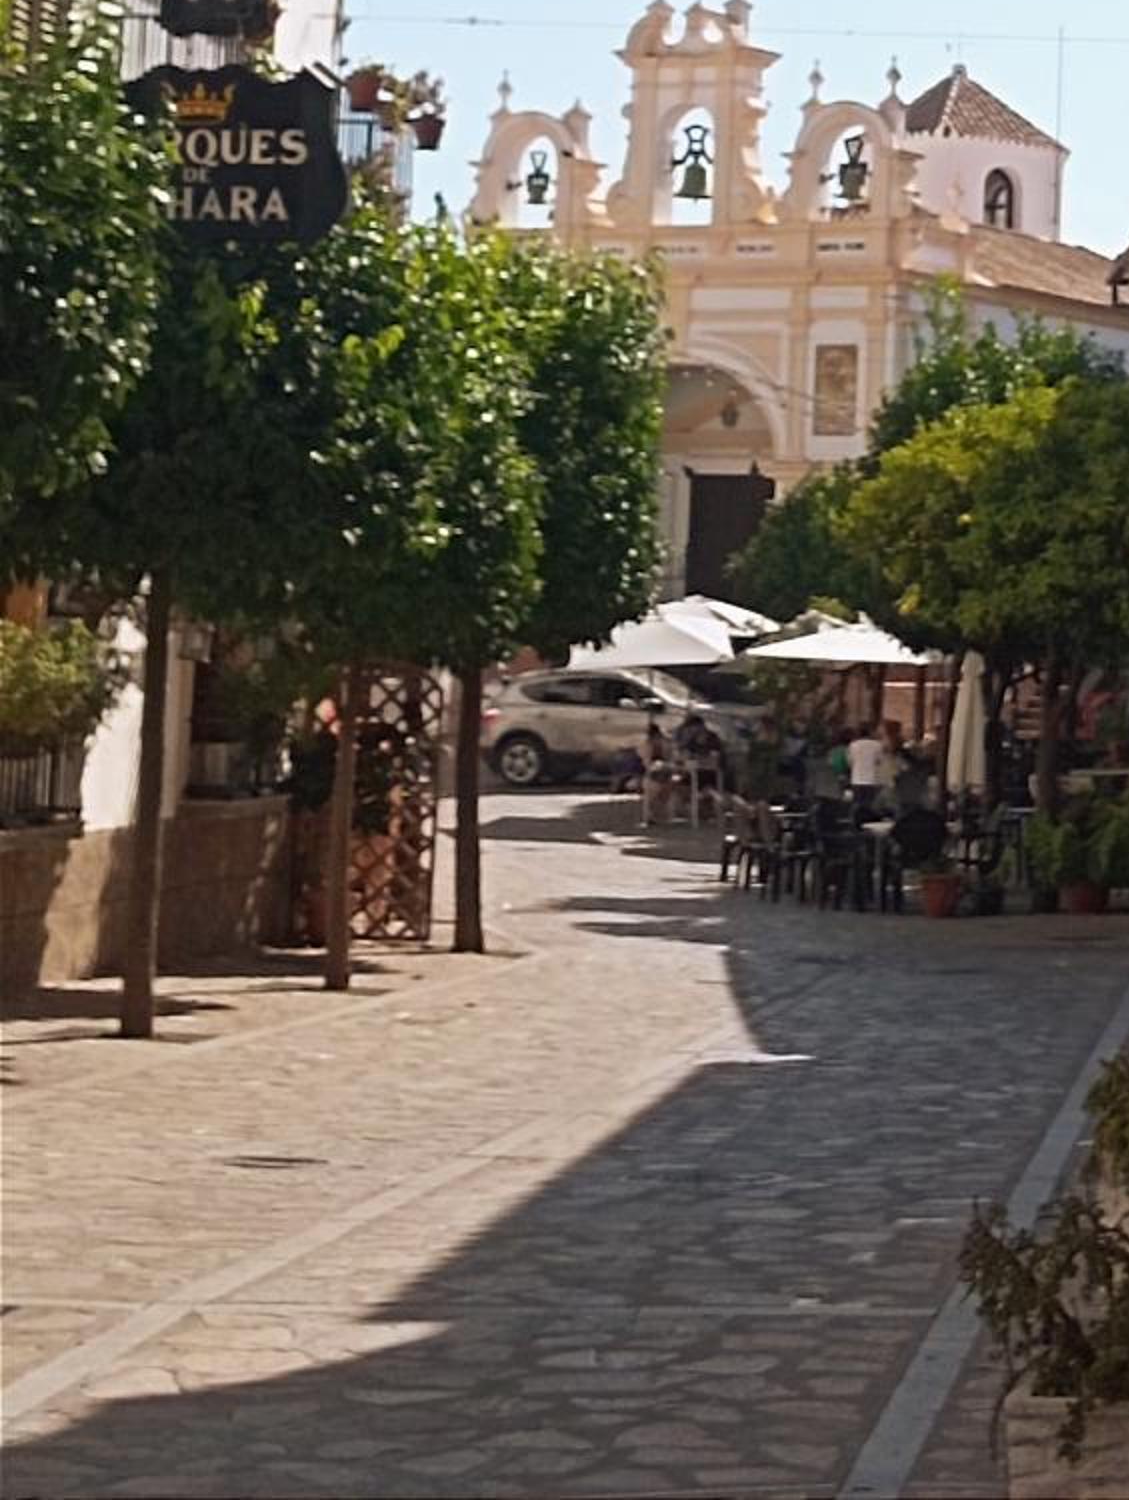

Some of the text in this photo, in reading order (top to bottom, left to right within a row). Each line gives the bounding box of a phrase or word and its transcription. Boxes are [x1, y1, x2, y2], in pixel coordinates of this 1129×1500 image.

[169, 126, 308, 168] RQUES
[182, 168, 210, 184] DE
[165, 185, 289, 226] HARA
